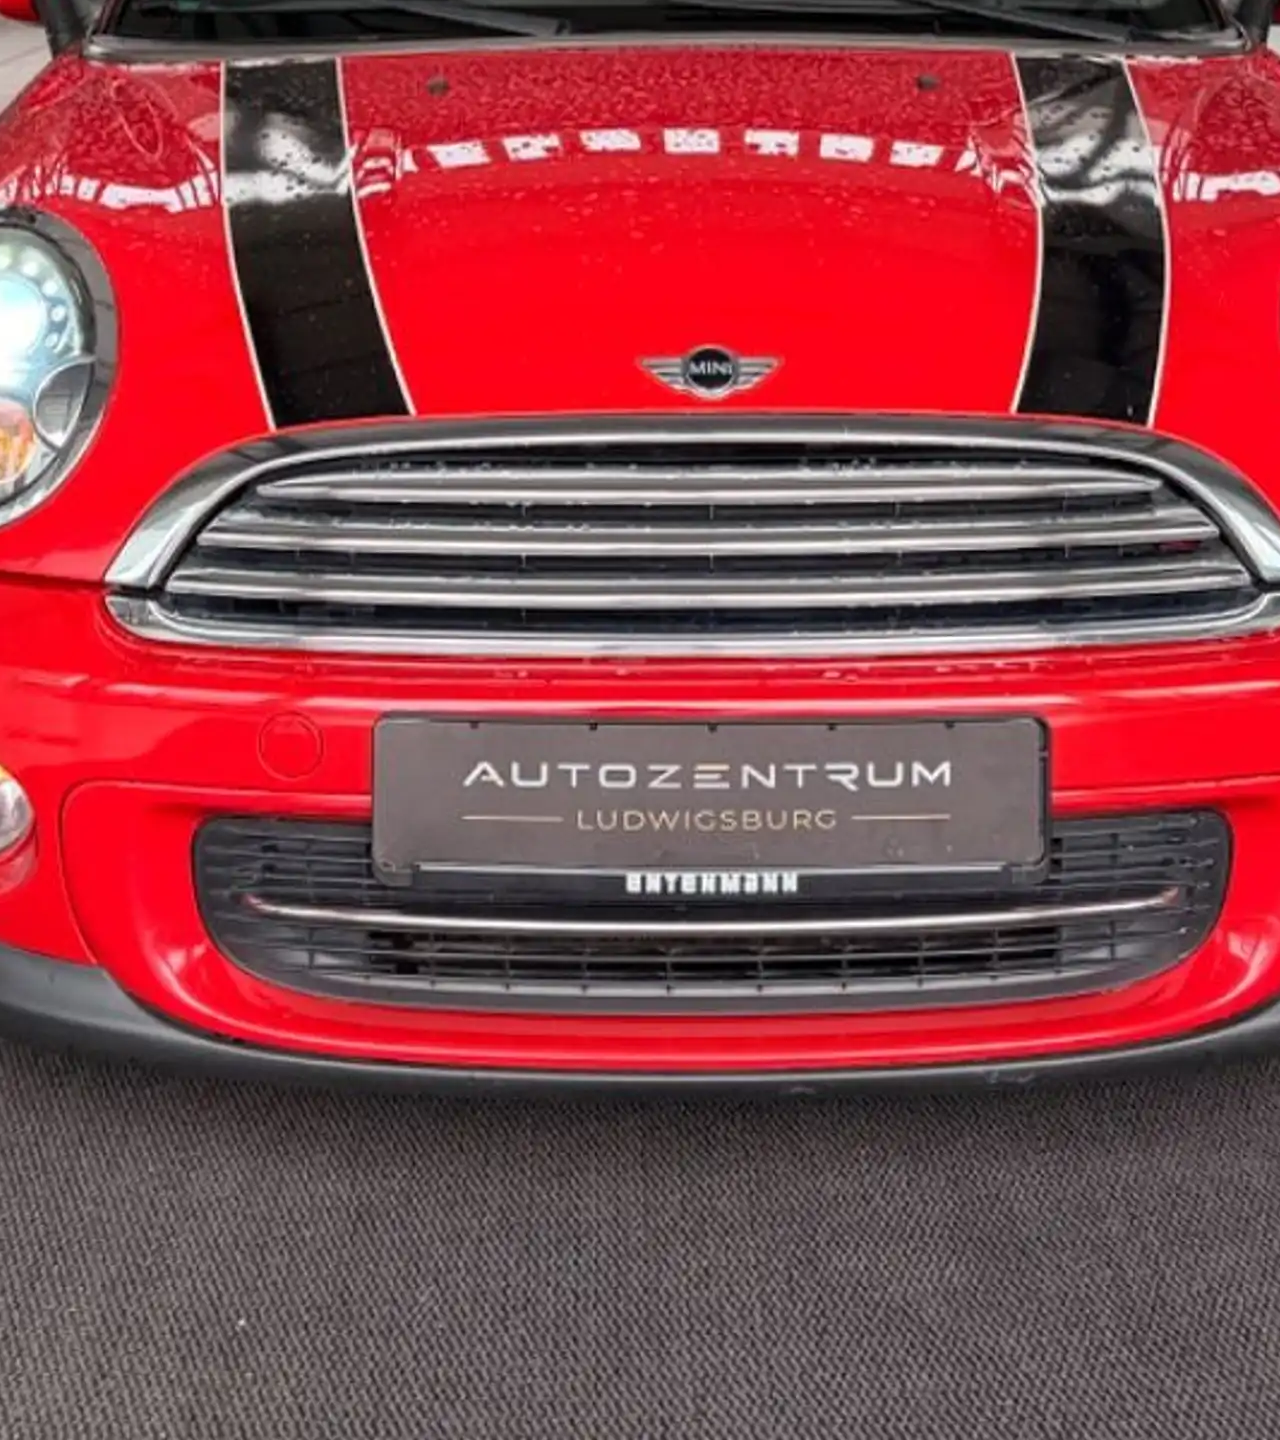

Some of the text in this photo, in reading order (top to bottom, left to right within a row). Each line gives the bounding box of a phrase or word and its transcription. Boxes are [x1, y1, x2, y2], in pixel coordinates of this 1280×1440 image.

[688, 359, 733, 376] MINI
[463, 760, 953, 791] AUTOZENTRUM
[577, 808, 838, 831] LUDWIGSBURG
